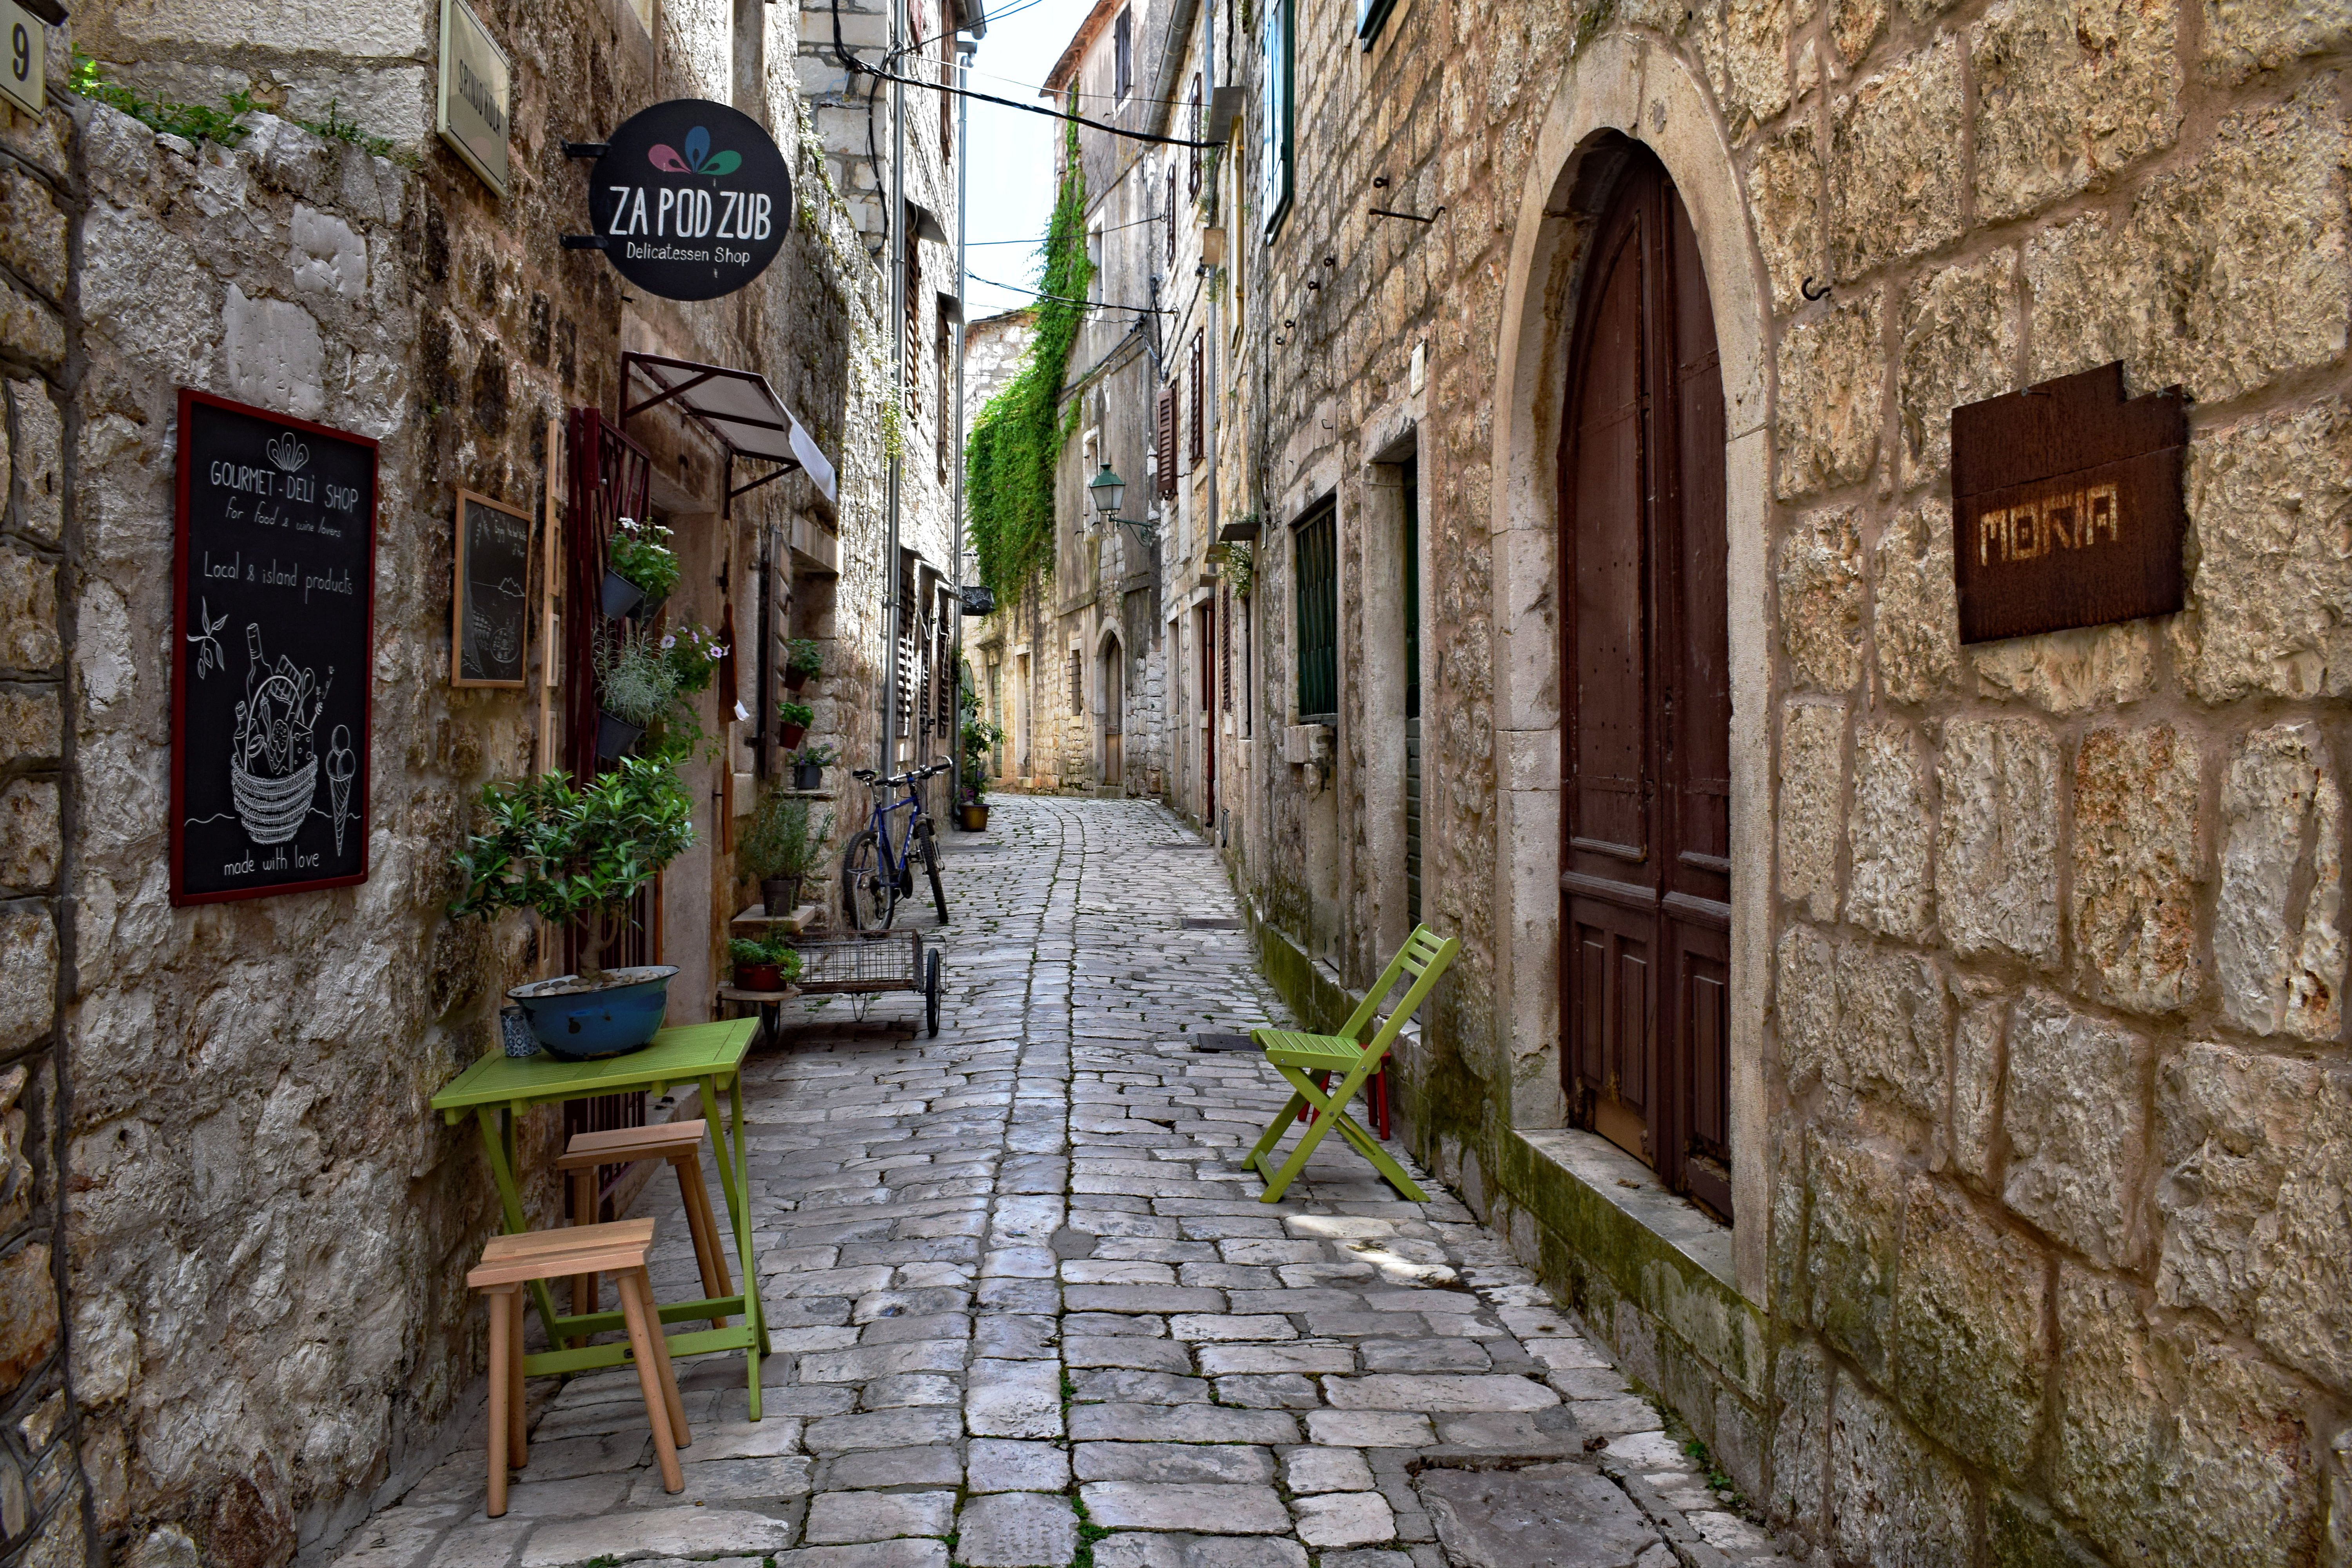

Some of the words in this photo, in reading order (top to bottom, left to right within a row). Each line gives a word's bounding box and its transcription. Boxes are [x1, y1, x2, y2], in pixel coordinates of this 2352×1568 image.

[13, 22, 29, 82] 9
[485, 89, 500, 137] KOLA
[609, 186, 648, 235] ZA
[658, 188, 712, 238] POD
[716, 191, 771, 240] ZUB
[627, 241, 709, 261] Delicatessen
[714, 247, 750, 267] Shop
[211, 461, 276, 496] GOURMET
[324, 484, 359, 513] SHOP
[281, 517, 289, 527] &
[296, 521, 314, 532] wine
[318, 517, 341, 537] lovers
[204, 551, 240, 579] Local
[247, 564, 255, 581] &
[263, 559, 297, 586] island
[305, 567, 352, 604] products
[224, 849, 255, 876] made
[263, 847, 287, 870] with
[295, 844, 319, 868] love
